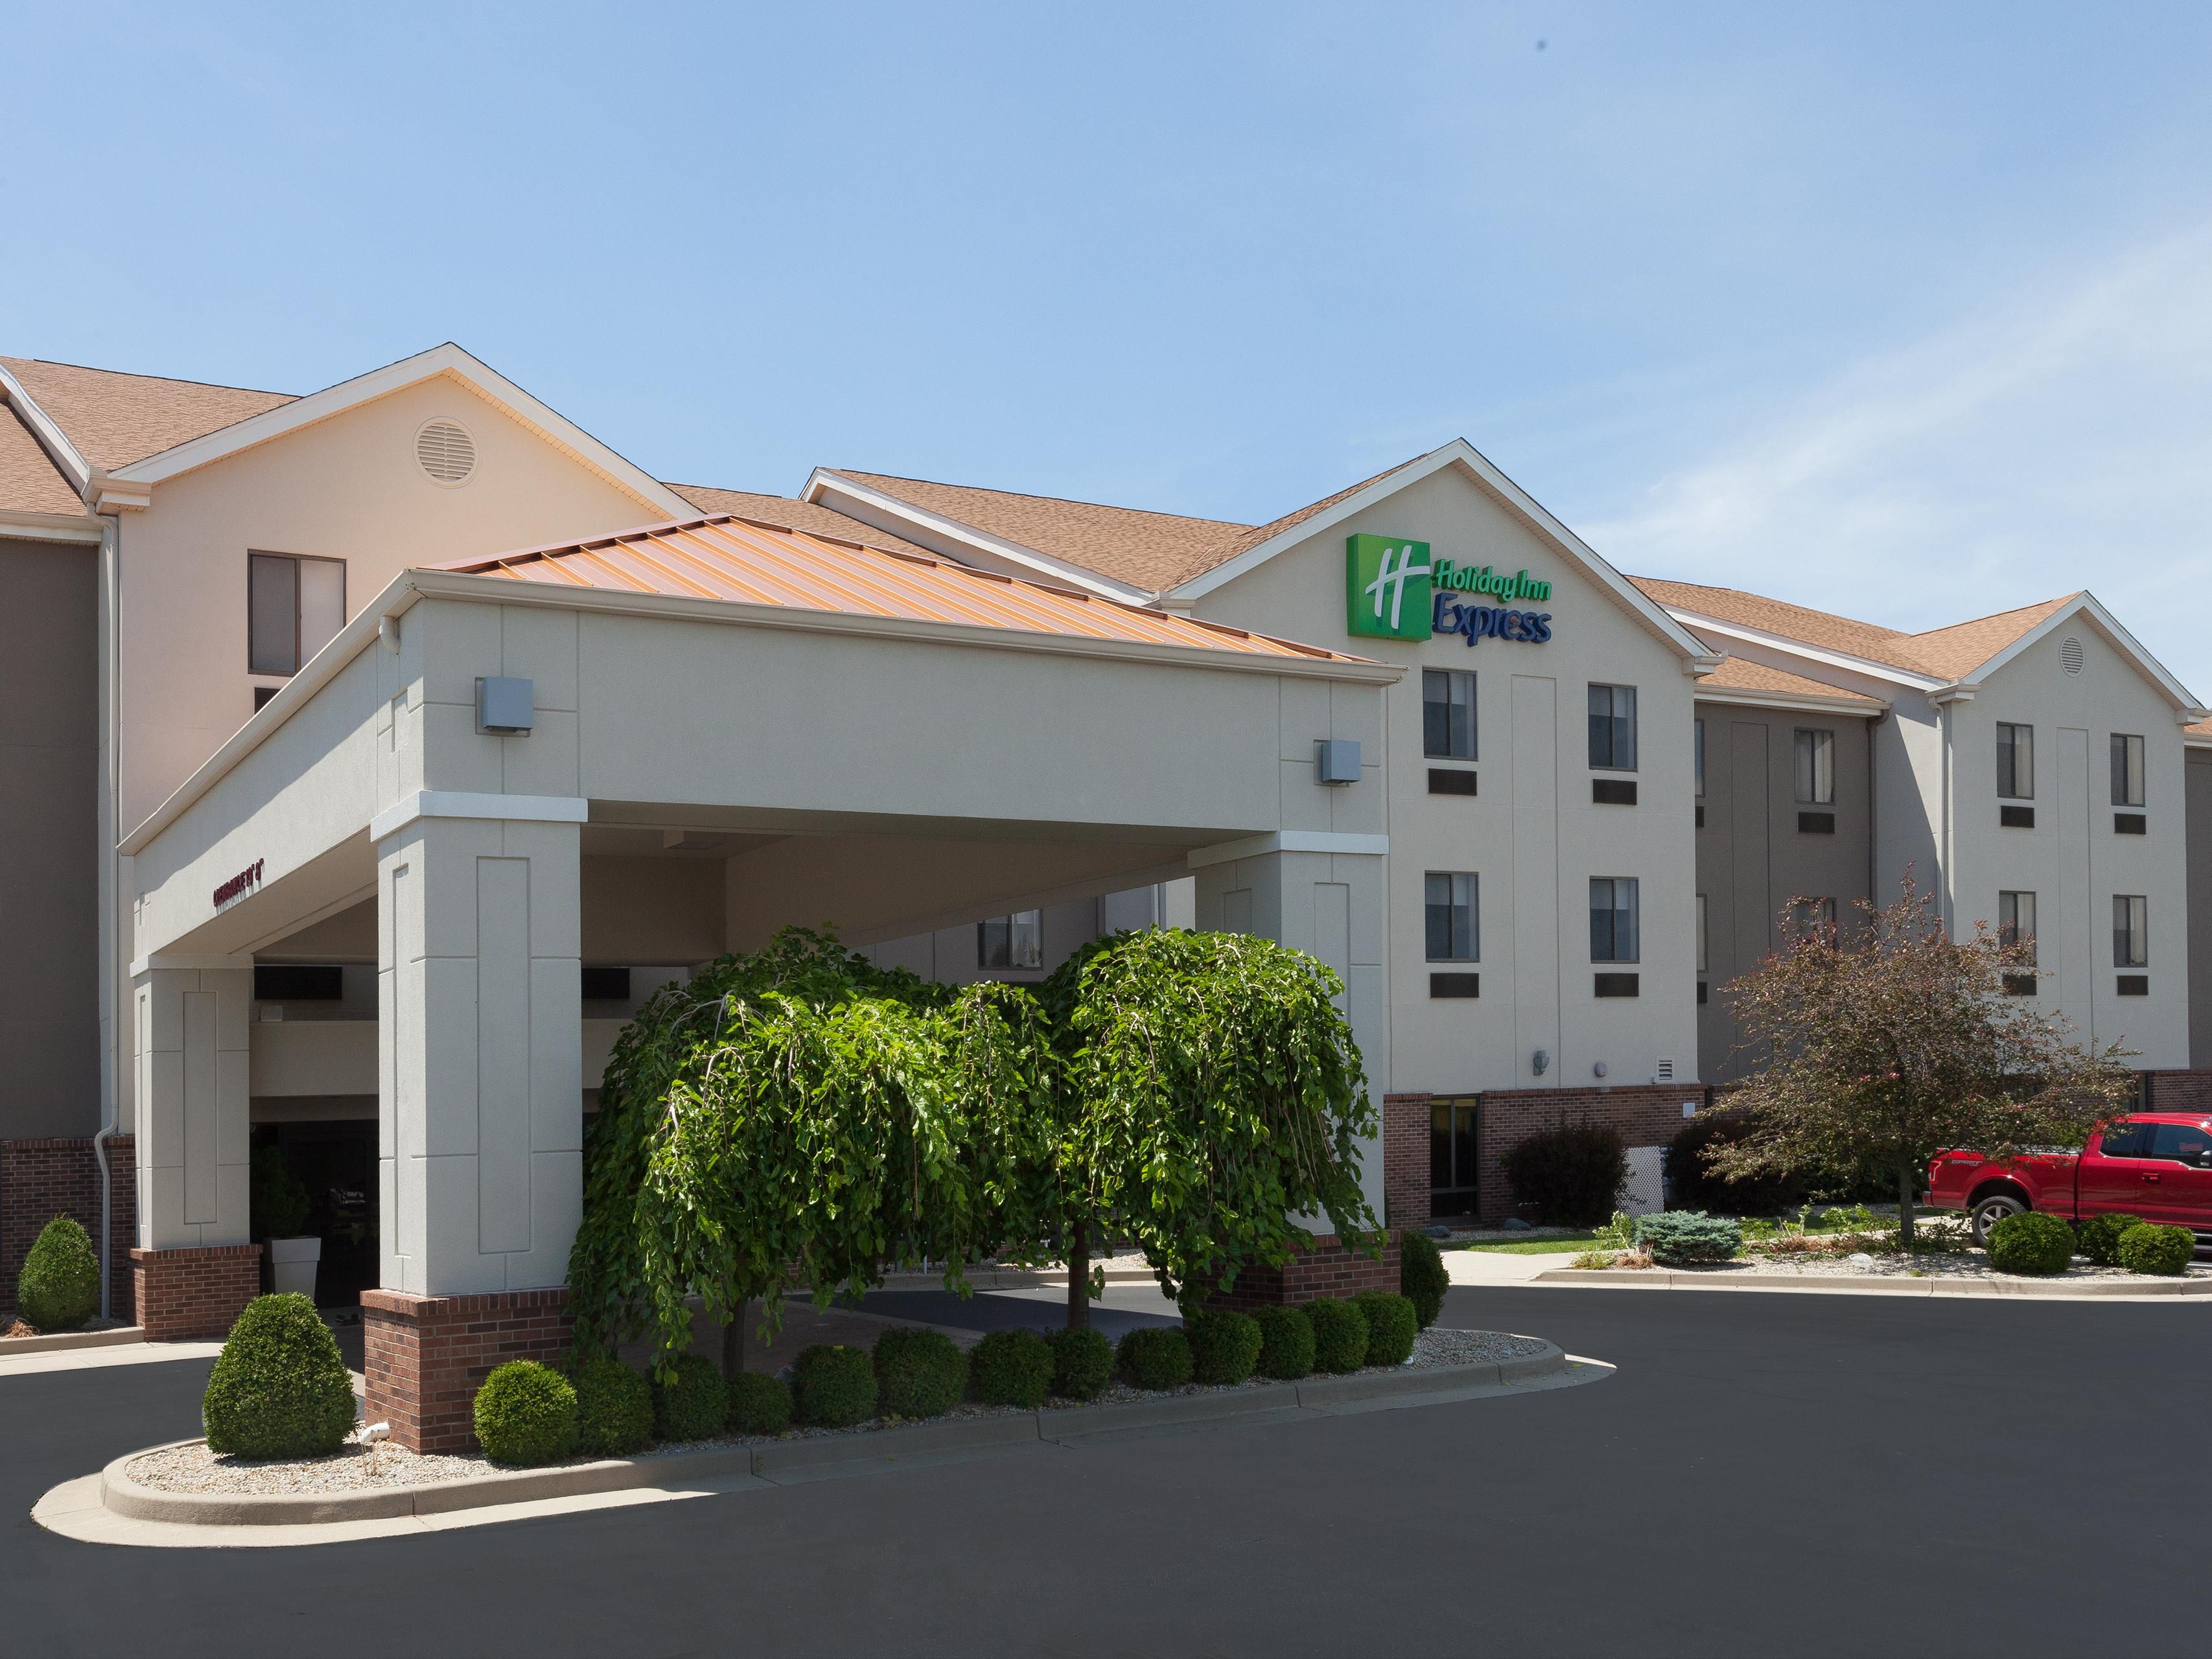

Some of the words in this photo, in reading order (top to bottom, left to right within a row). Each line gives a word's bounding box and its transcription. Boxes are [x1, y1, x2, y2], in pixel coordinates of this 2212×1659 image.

[1432, 559, 1517, 604] Holiday
[1517, 569, 1552, 601] Inn
[1432, 592, 1552, 647] Express
